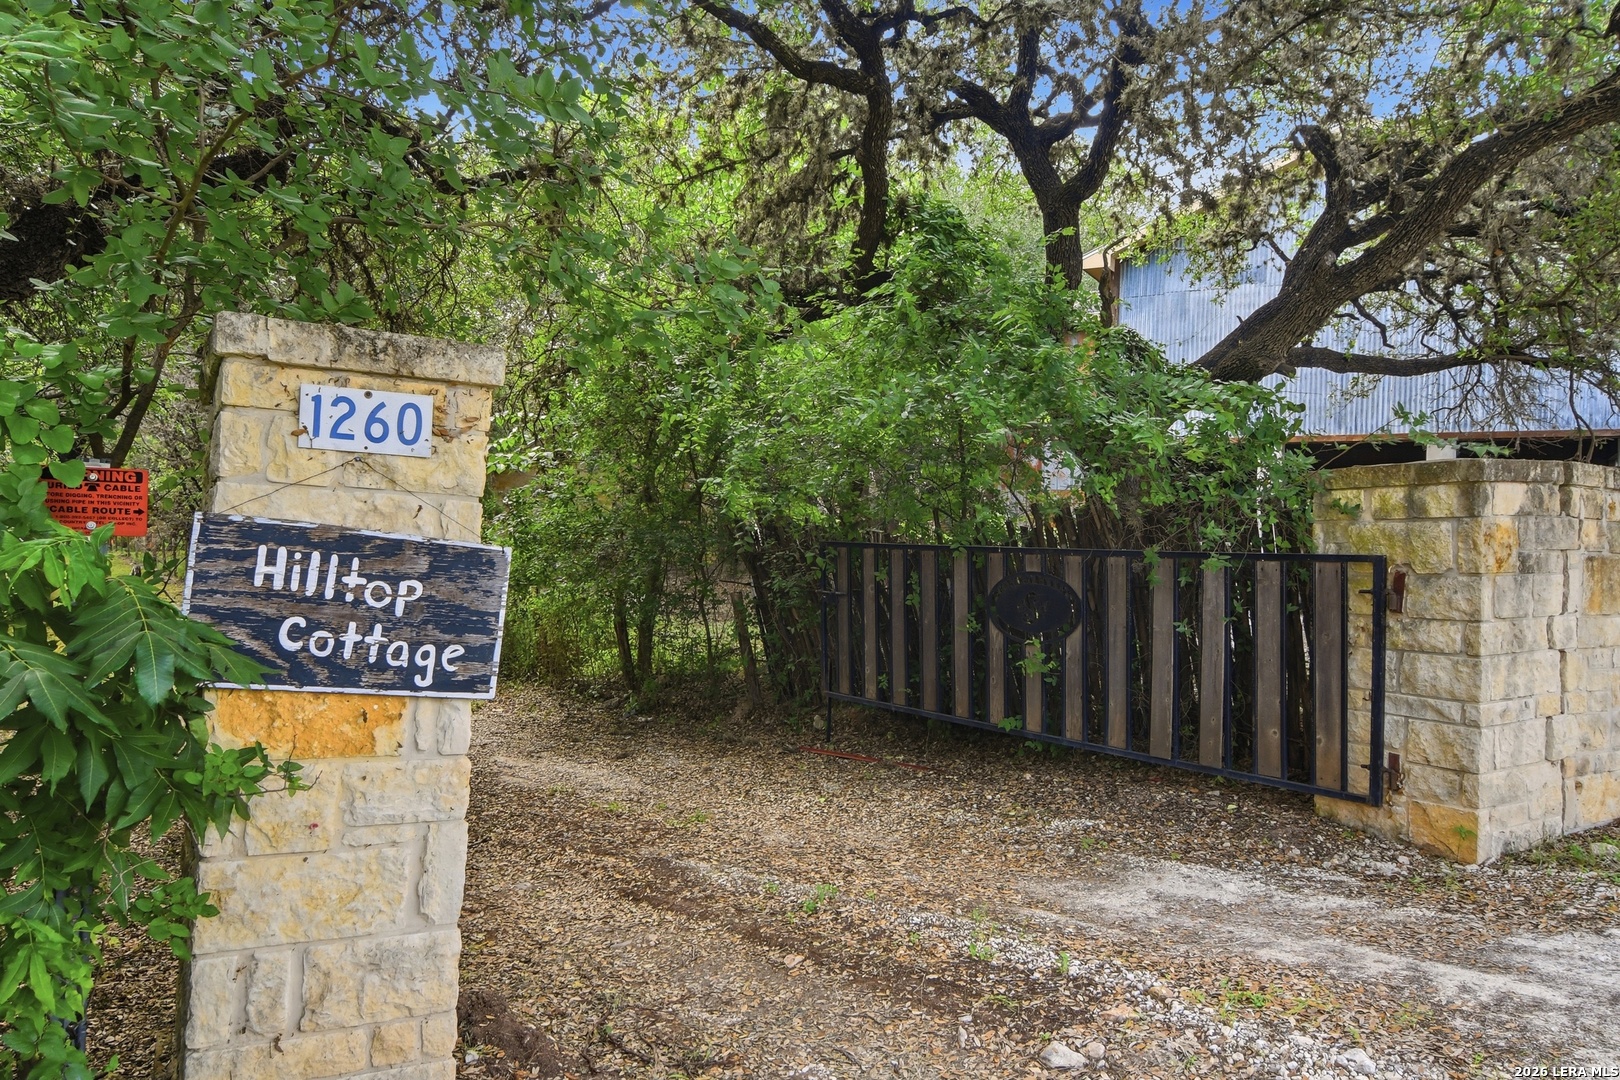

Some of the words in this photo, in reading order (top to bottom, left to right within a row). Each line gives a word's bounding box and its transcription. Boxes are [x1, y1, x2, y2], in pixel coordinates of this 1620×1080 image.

[311, 394, 423, 447] 1260
[49, 505, 89, 514] CABLE
[92, 506, 131, 515] ROUTE
[104, 484, 141, 493] CABLE
[253, 544, 424, 617] Hilltop
[278, 616, 465, 687] Cottage
